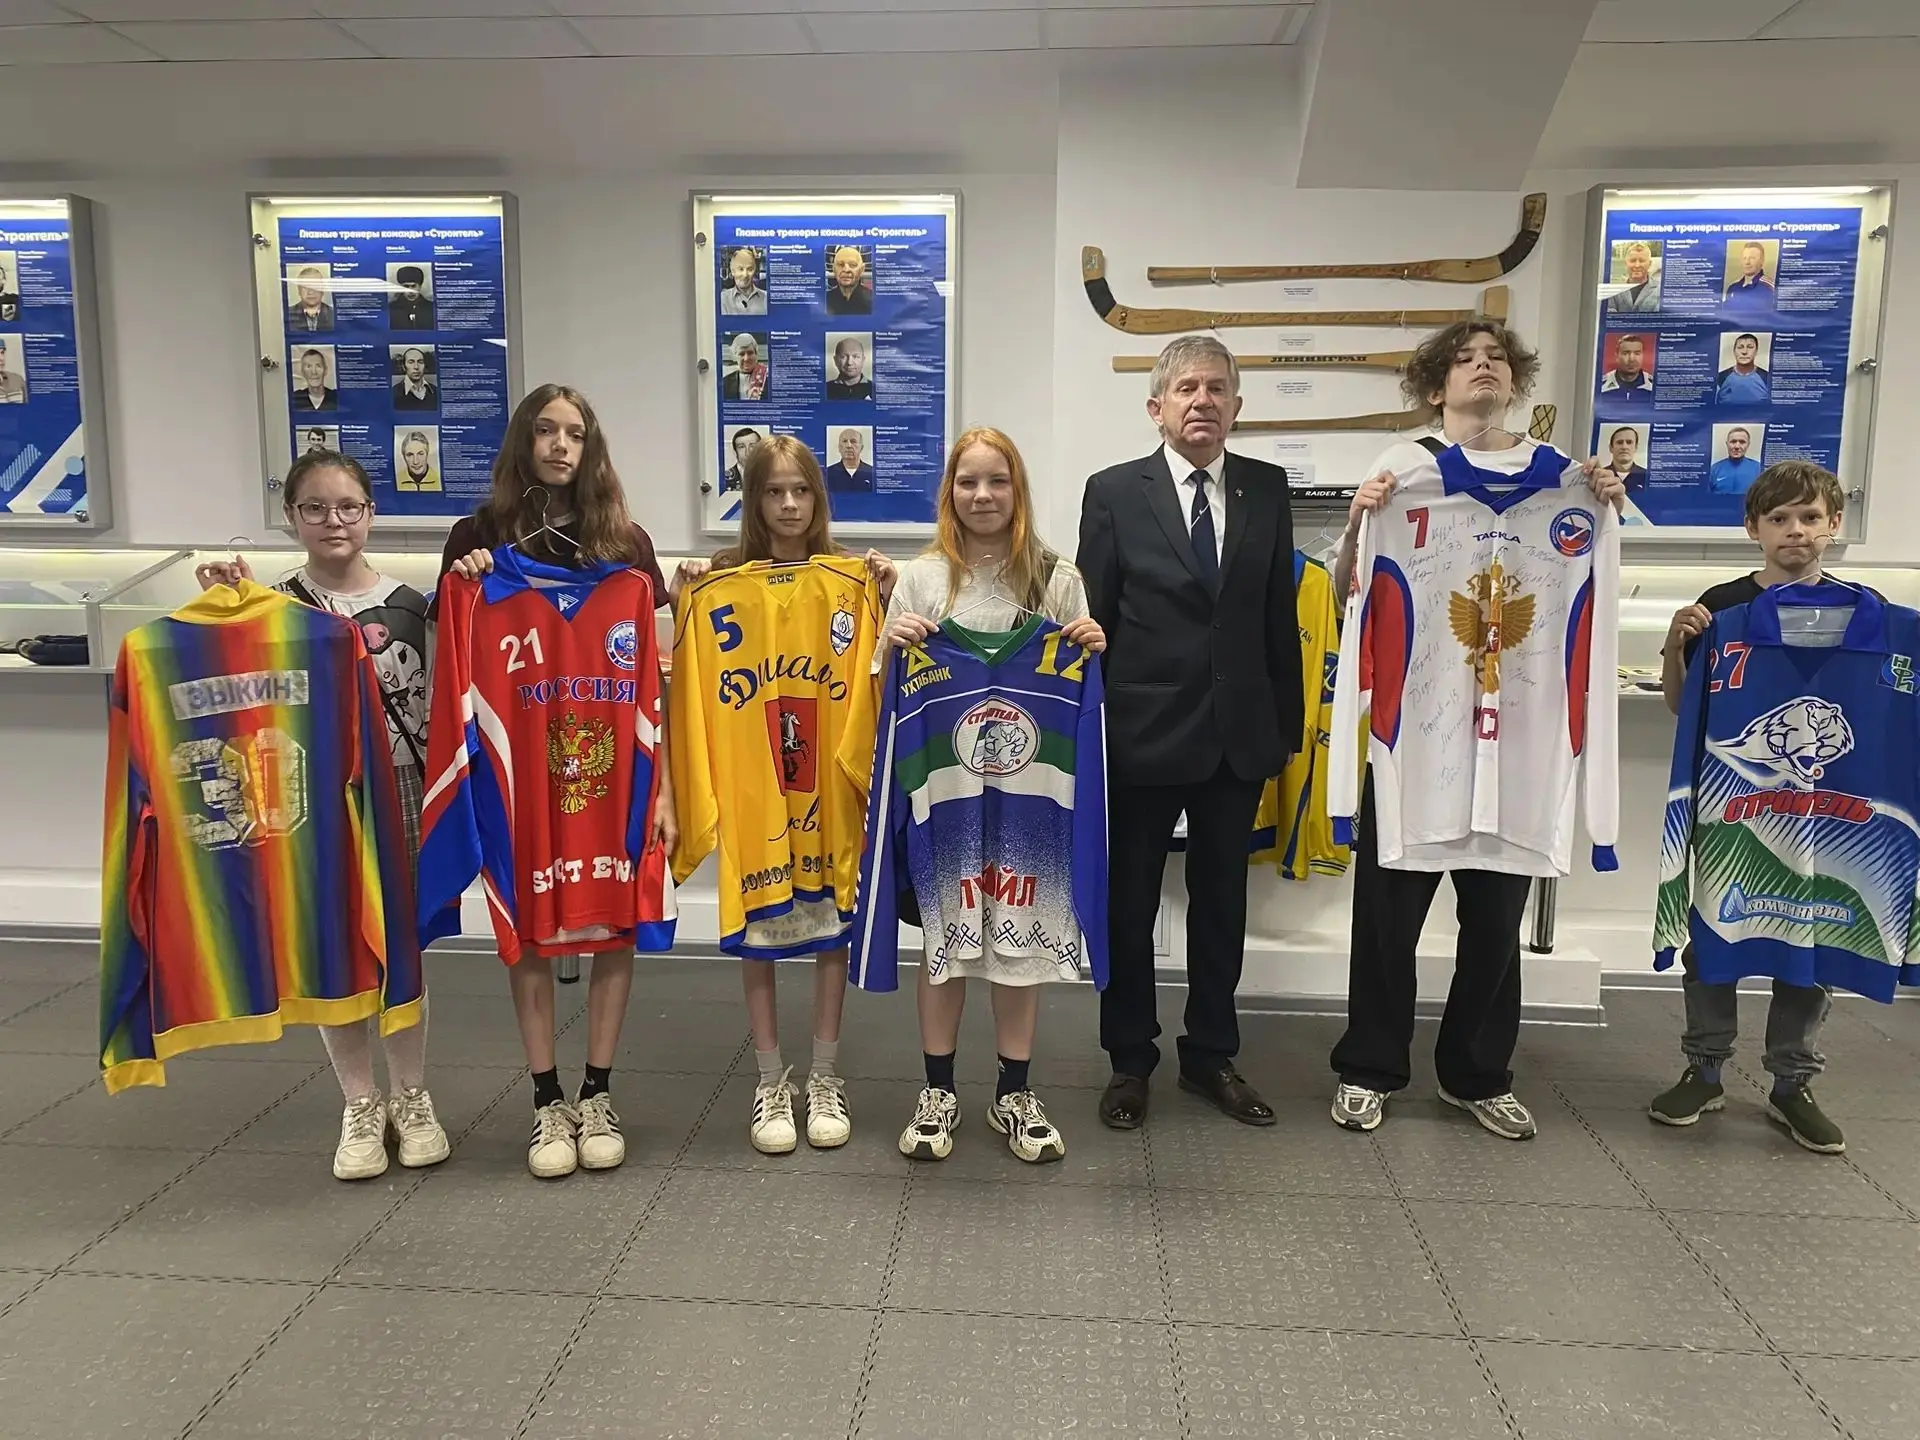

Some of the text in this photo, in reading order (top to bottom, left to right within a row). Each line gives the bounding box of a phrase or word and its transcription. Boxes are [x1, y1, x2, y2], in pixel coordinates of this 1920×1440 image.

[299, 229, 338, 238] Главные
[339, 231, 379, 240] тренеры
[381, 230, 423, 239] команды
[735, 227, 775, 237] Главные
[777, 229, 819, 238] тренеры
[820, 229, 863, 238] команды
[1629, 222, 1673, 232] Главные
[1675, 224, 1720, 234] тренеры
[1722, 224, 1770, 233] команды
[1405, 506, 1429, 549] 7
[1472, 530, 1521, 544] TACKLA
[709, 604, 744, 653] 5
[500, 627, 544, 674] 21
[1034, 630, 1091, 683] 12
[1709, 641, 1753, 693] 27
[517, 676, 637, 710] РОССИЯ
